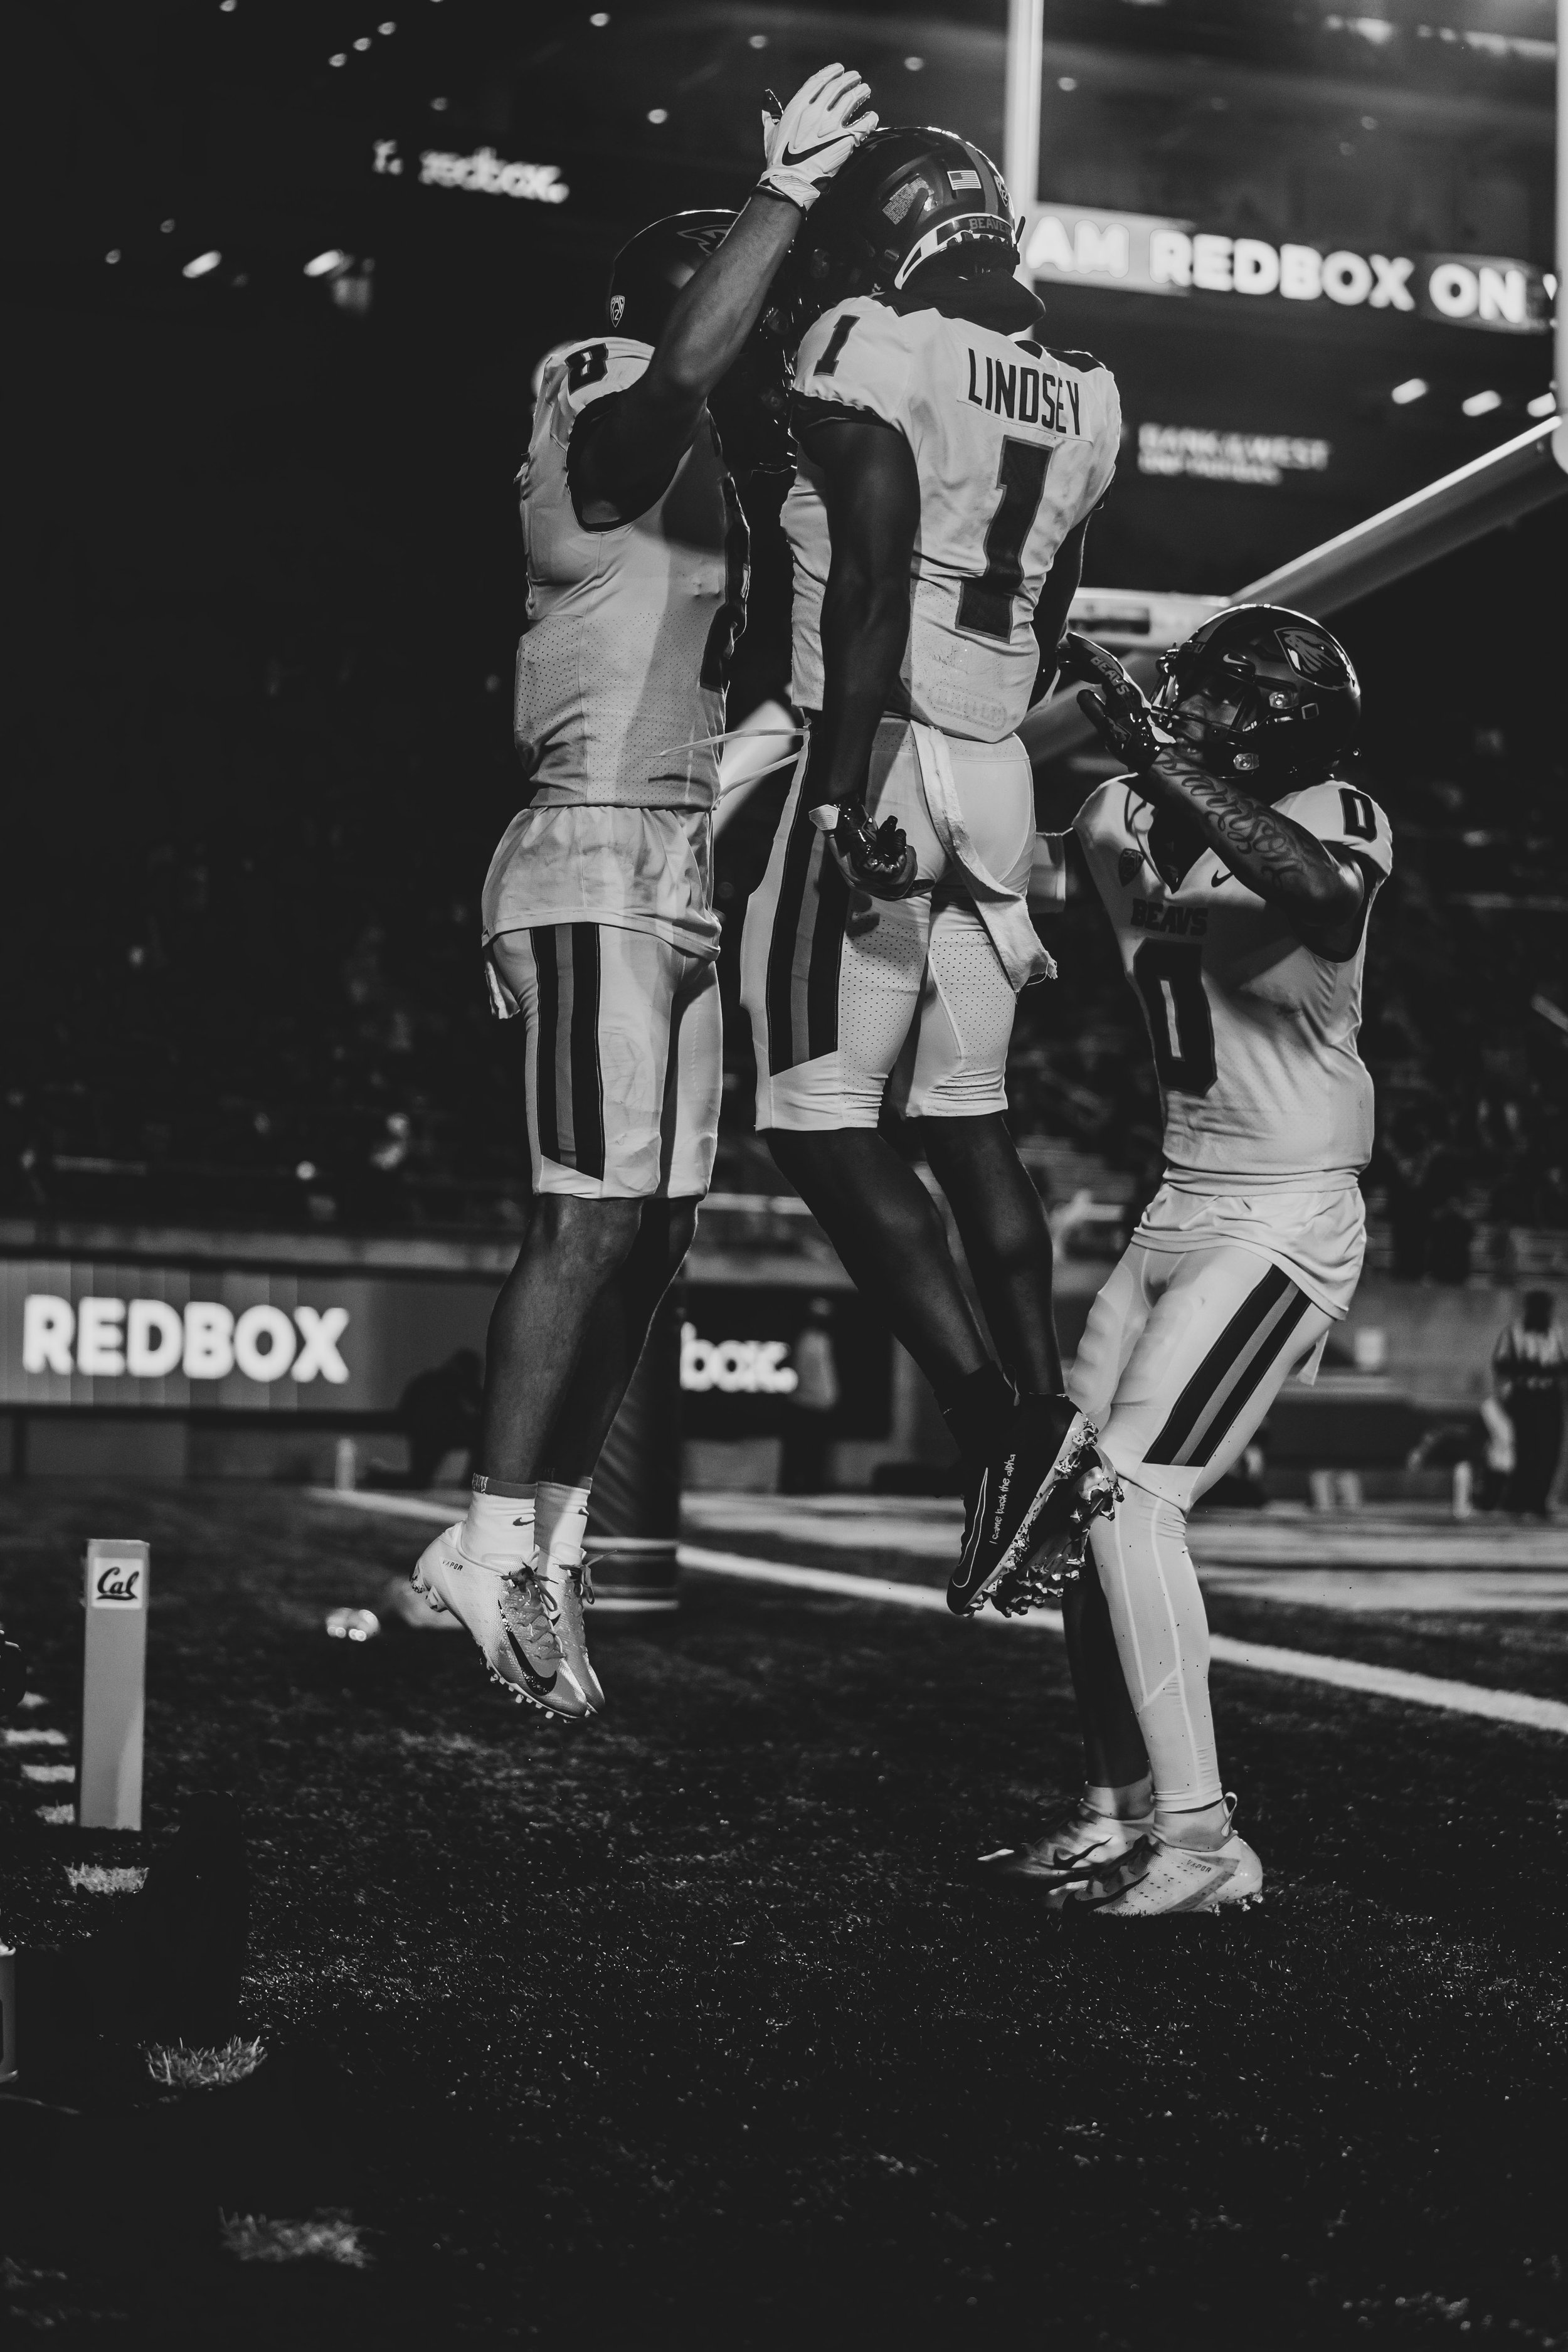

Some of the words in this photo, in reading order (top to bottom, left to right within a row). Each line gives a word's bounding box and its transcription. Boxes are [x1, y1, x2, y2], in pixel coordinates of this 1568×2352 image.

[1150, 229, 1416, 312] REDBOX
[1429, 263, 1527, 323] ON
[612, 296, 624, 307] PAC
[612, 309, 620, 321] 12
[813, 314, 861, 376] 1
[564, 342, 608, 396] 8
[968, 347, 1080, 435] LINDSEY
[955, 435, 1054, 644] 1
[1090, 656, 1130, 695] BEAVS
[1131, 898, 1208, 936] BEAVS
[23, 1295, 349, 1384] REDBOX
[1004, 1454, 1016, 1477] alpha
[999, 1478, 1011, 1492] the
[995, 1493, 1007, 1514] back
[992, 1516, 1003, 1540] came
[97, 1567, 139, 1601] Cal
[1187, 1859, 1211, 1873] VAPOR
